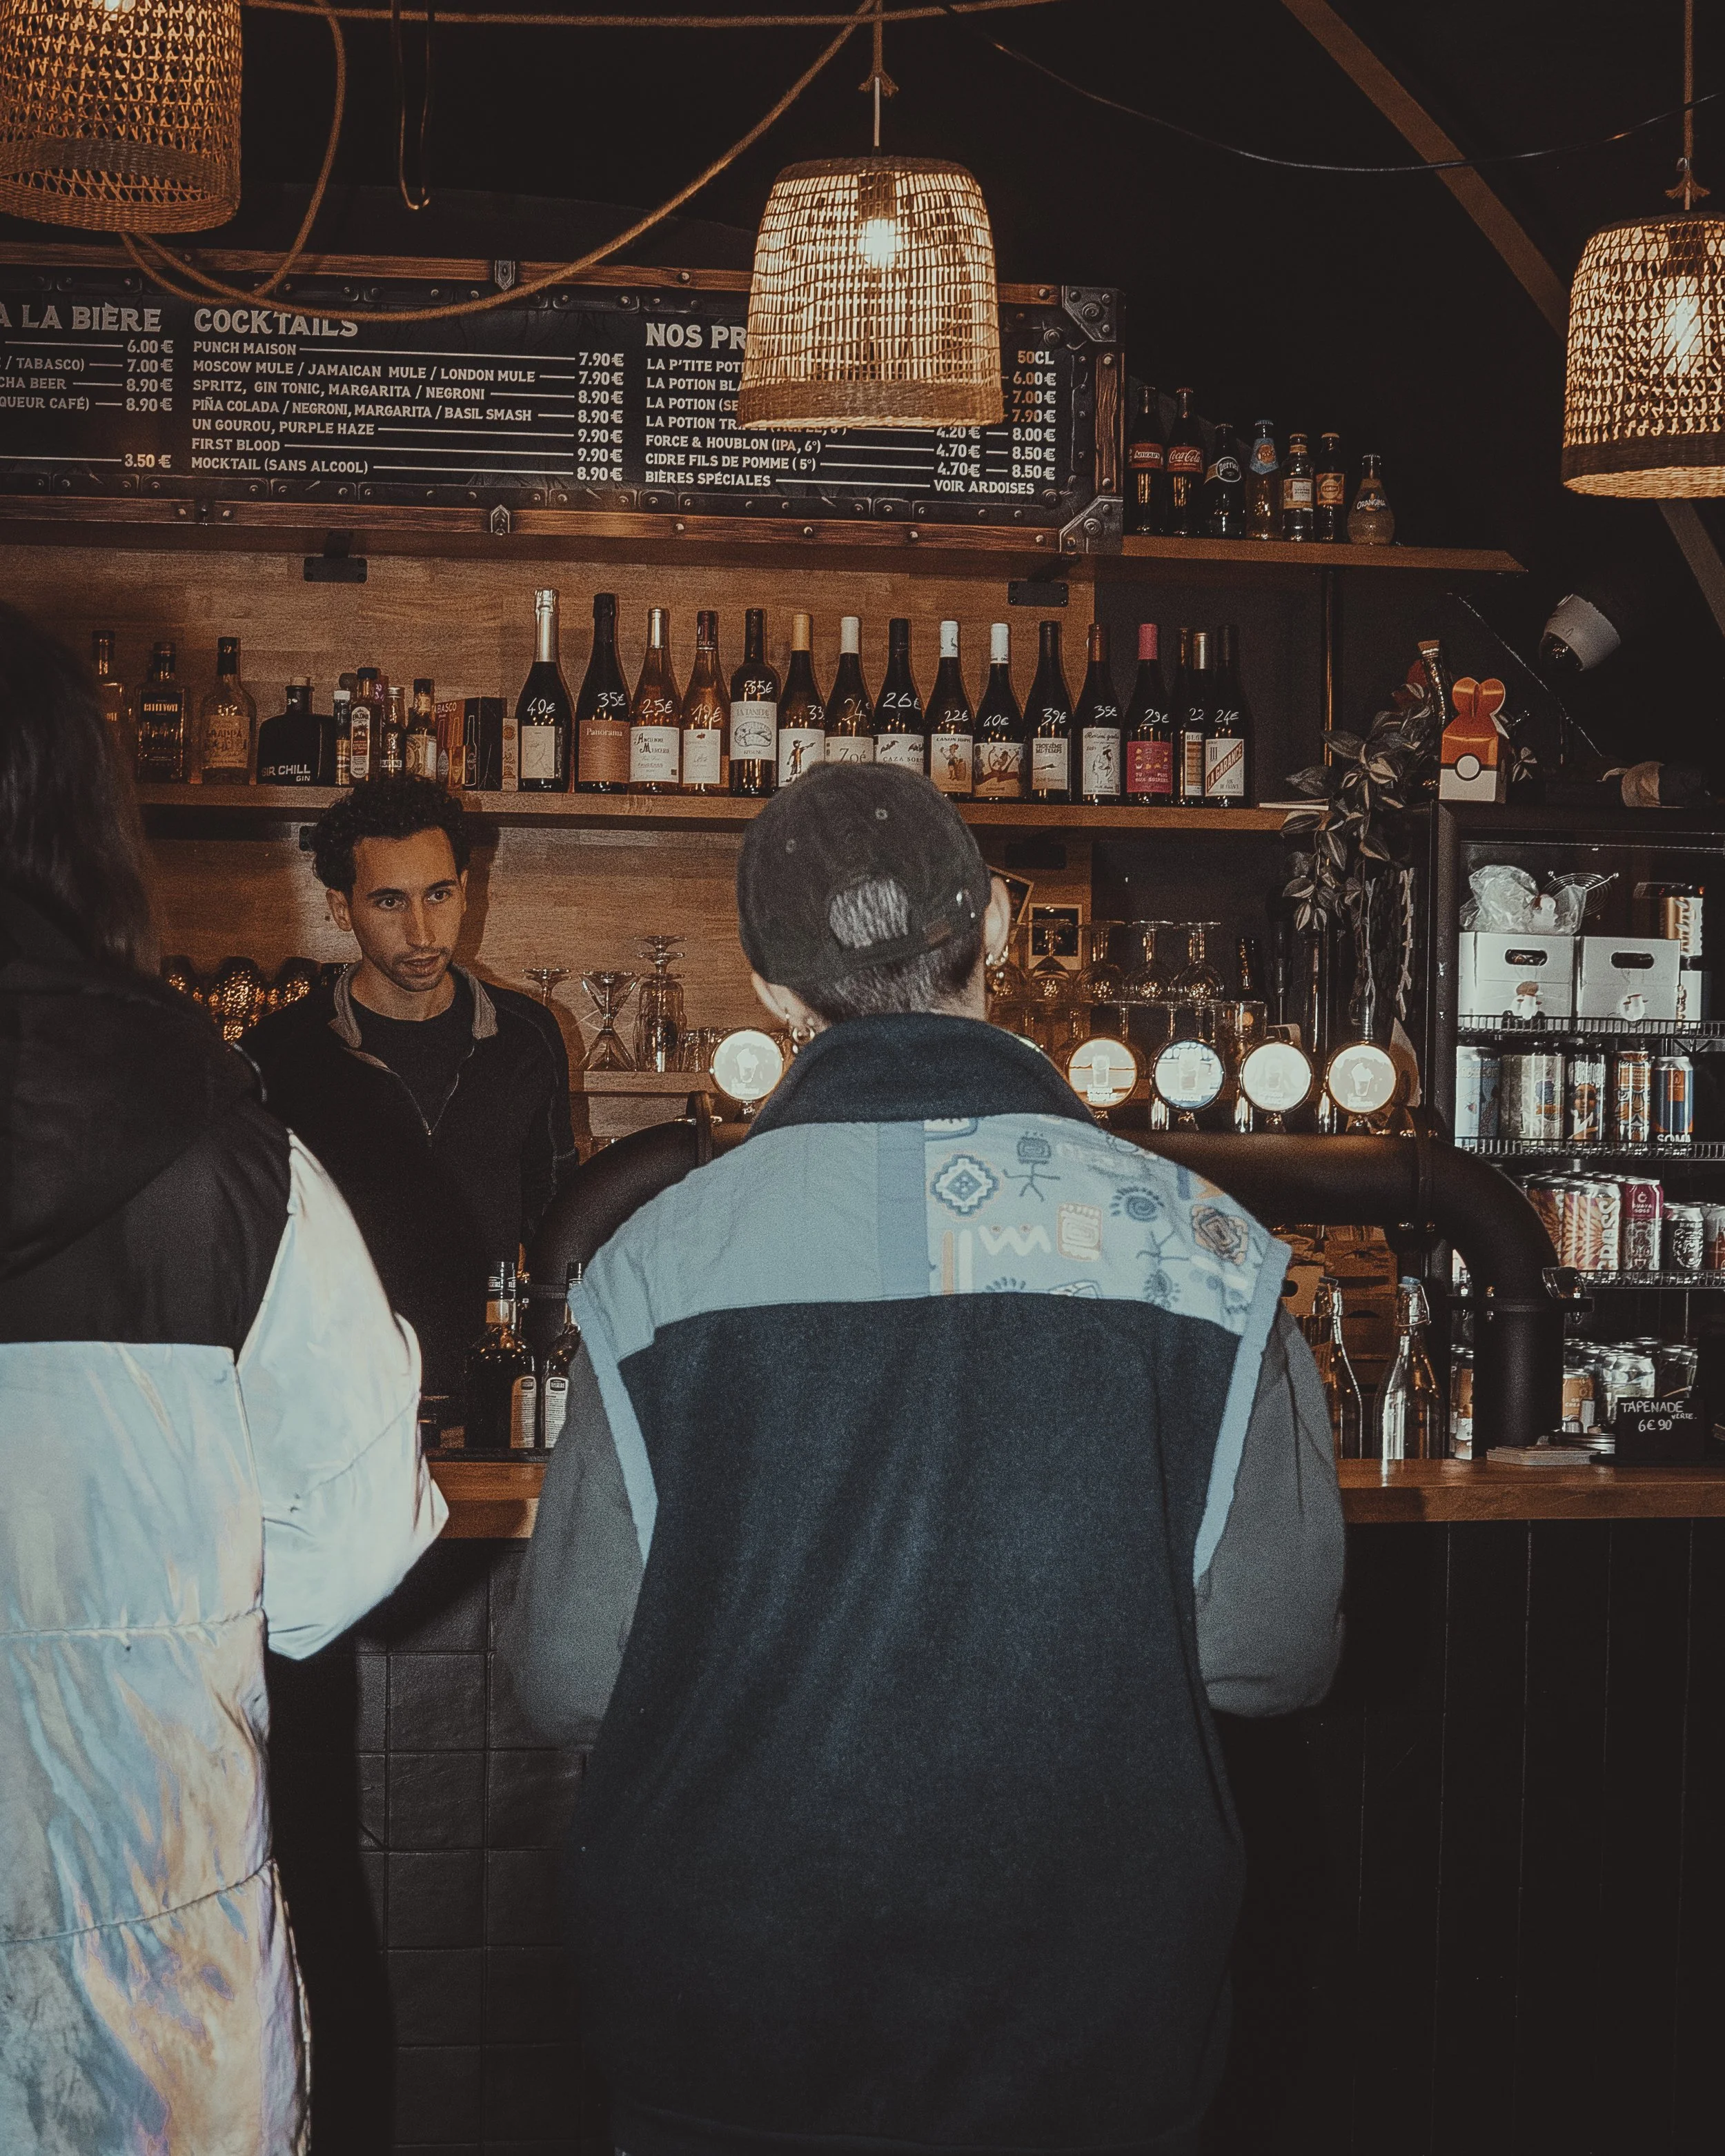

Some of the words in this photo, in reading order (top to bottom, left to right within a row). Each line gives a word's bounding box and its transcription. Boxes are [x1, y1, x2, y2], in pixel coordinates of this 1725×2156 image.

[22, 305, 63, 329] LA
[72, 301, 162, 332] BIÈRE
[194, 308, 358, 337] COCKTAILS
[646, 322, 703, 348] NOS
[711, 325, 747, 350] PR
[194, 341, 239, 354] PUNCH
[243, 343, 297, 356] MAISON
[17, 357, 84, 372] TABASCO)
[647, 358, 664, 370] LA
[669, 359, 712, 372] P'TITE
[1018, 350, 1054, 366] 50CL
[193, 360, 250, 373] MOSCOW
[255, 362, 294, 375] MULE
[308, 363, 382, 378] JAMAICAN
[388, 366, 426, 379] MULE
[441, 368, 494, 382] LONDON
[497, 370, 535, 383] MULE
[0, 377, 26, 388] CHA
[30, 377, 67, 390] BEER
[193, 380, 247, 395] SPRITZ,
[254, 381, 277, 394] GIN
[281, 382, 324, 397] TONIC,
[328, 384, 411, 398] MARGARITA
[426, 386, 485, 400] NEGRONI
[647, 377, 664, 389] LA
[669, 378, 716, 391] POTION
[0, 397, 45, 408] QUEUR
[50, 396, 90, 411] CAFÉ)
[193, 397, 224, 412] PIÑA
[227, 399, 279, 413] COLADA
[293, 401, 351, 417] NEGRONI,
[354, 404, 432, 418] MARGARITA
[444, 407, 483, 420] BASIL
[486, 408, 532, 422] SMASH
[646, 397, 664, 408] LA
[669, 397, 716, 411] POTION
[193, 417, 212, 431] UN
[215, 419, 275, 435] GOUROU,
[279, 421, 333, 435] PURPLE
[337, 423, 375, 436] HAZE
[646, 415, 664, 427] LA
[668, 416, 716, 429] POTION
[192, 437, 233, 451] FIRST
[236, 439, 281, 452] BLOOD
[646, 435, 689, 447] FORCE
[692, 437, 702, 448] &
[707, 437, 769, 451] HOUBLON
[771, 439, 801, 454] (IPA,
[646, 453, 685, 466] CIDRE
[689, 454, 718, 467] FILS
[722, 455, 739, 468] DE
[742, 456, 789, 470] POMME
[1169, 449, 1201, 464] Coca-Cola
[191, 456, 261, 471] MOCKTAIL
[264, 456, 307, 472] (SANS
[311, 459, 368, 475] ALCOOL)
[645, 469, 694, 484] BIÈRES
[697, 471, 771, 487] SPÉCIALES
[934, 479, 965, 493] VOIR
[969, 481, 1035, 495] ARDOISES
[598, 692, 626, 708] 35€
[642, 698, 673, 714] 25€
[883, 692, 922, 711] 26€
[807, 704, 825, 720] 33
[944, 710, 969, 723] 22€
[1094, 705, 1117, 719] 35€
[586, 727, 623, 737] Panorama
[839, 747, 867, 763] Zoé
[278, 764, 310, 775] CHILL
[1620, 1401, 1684, 1414] TAPENADE
